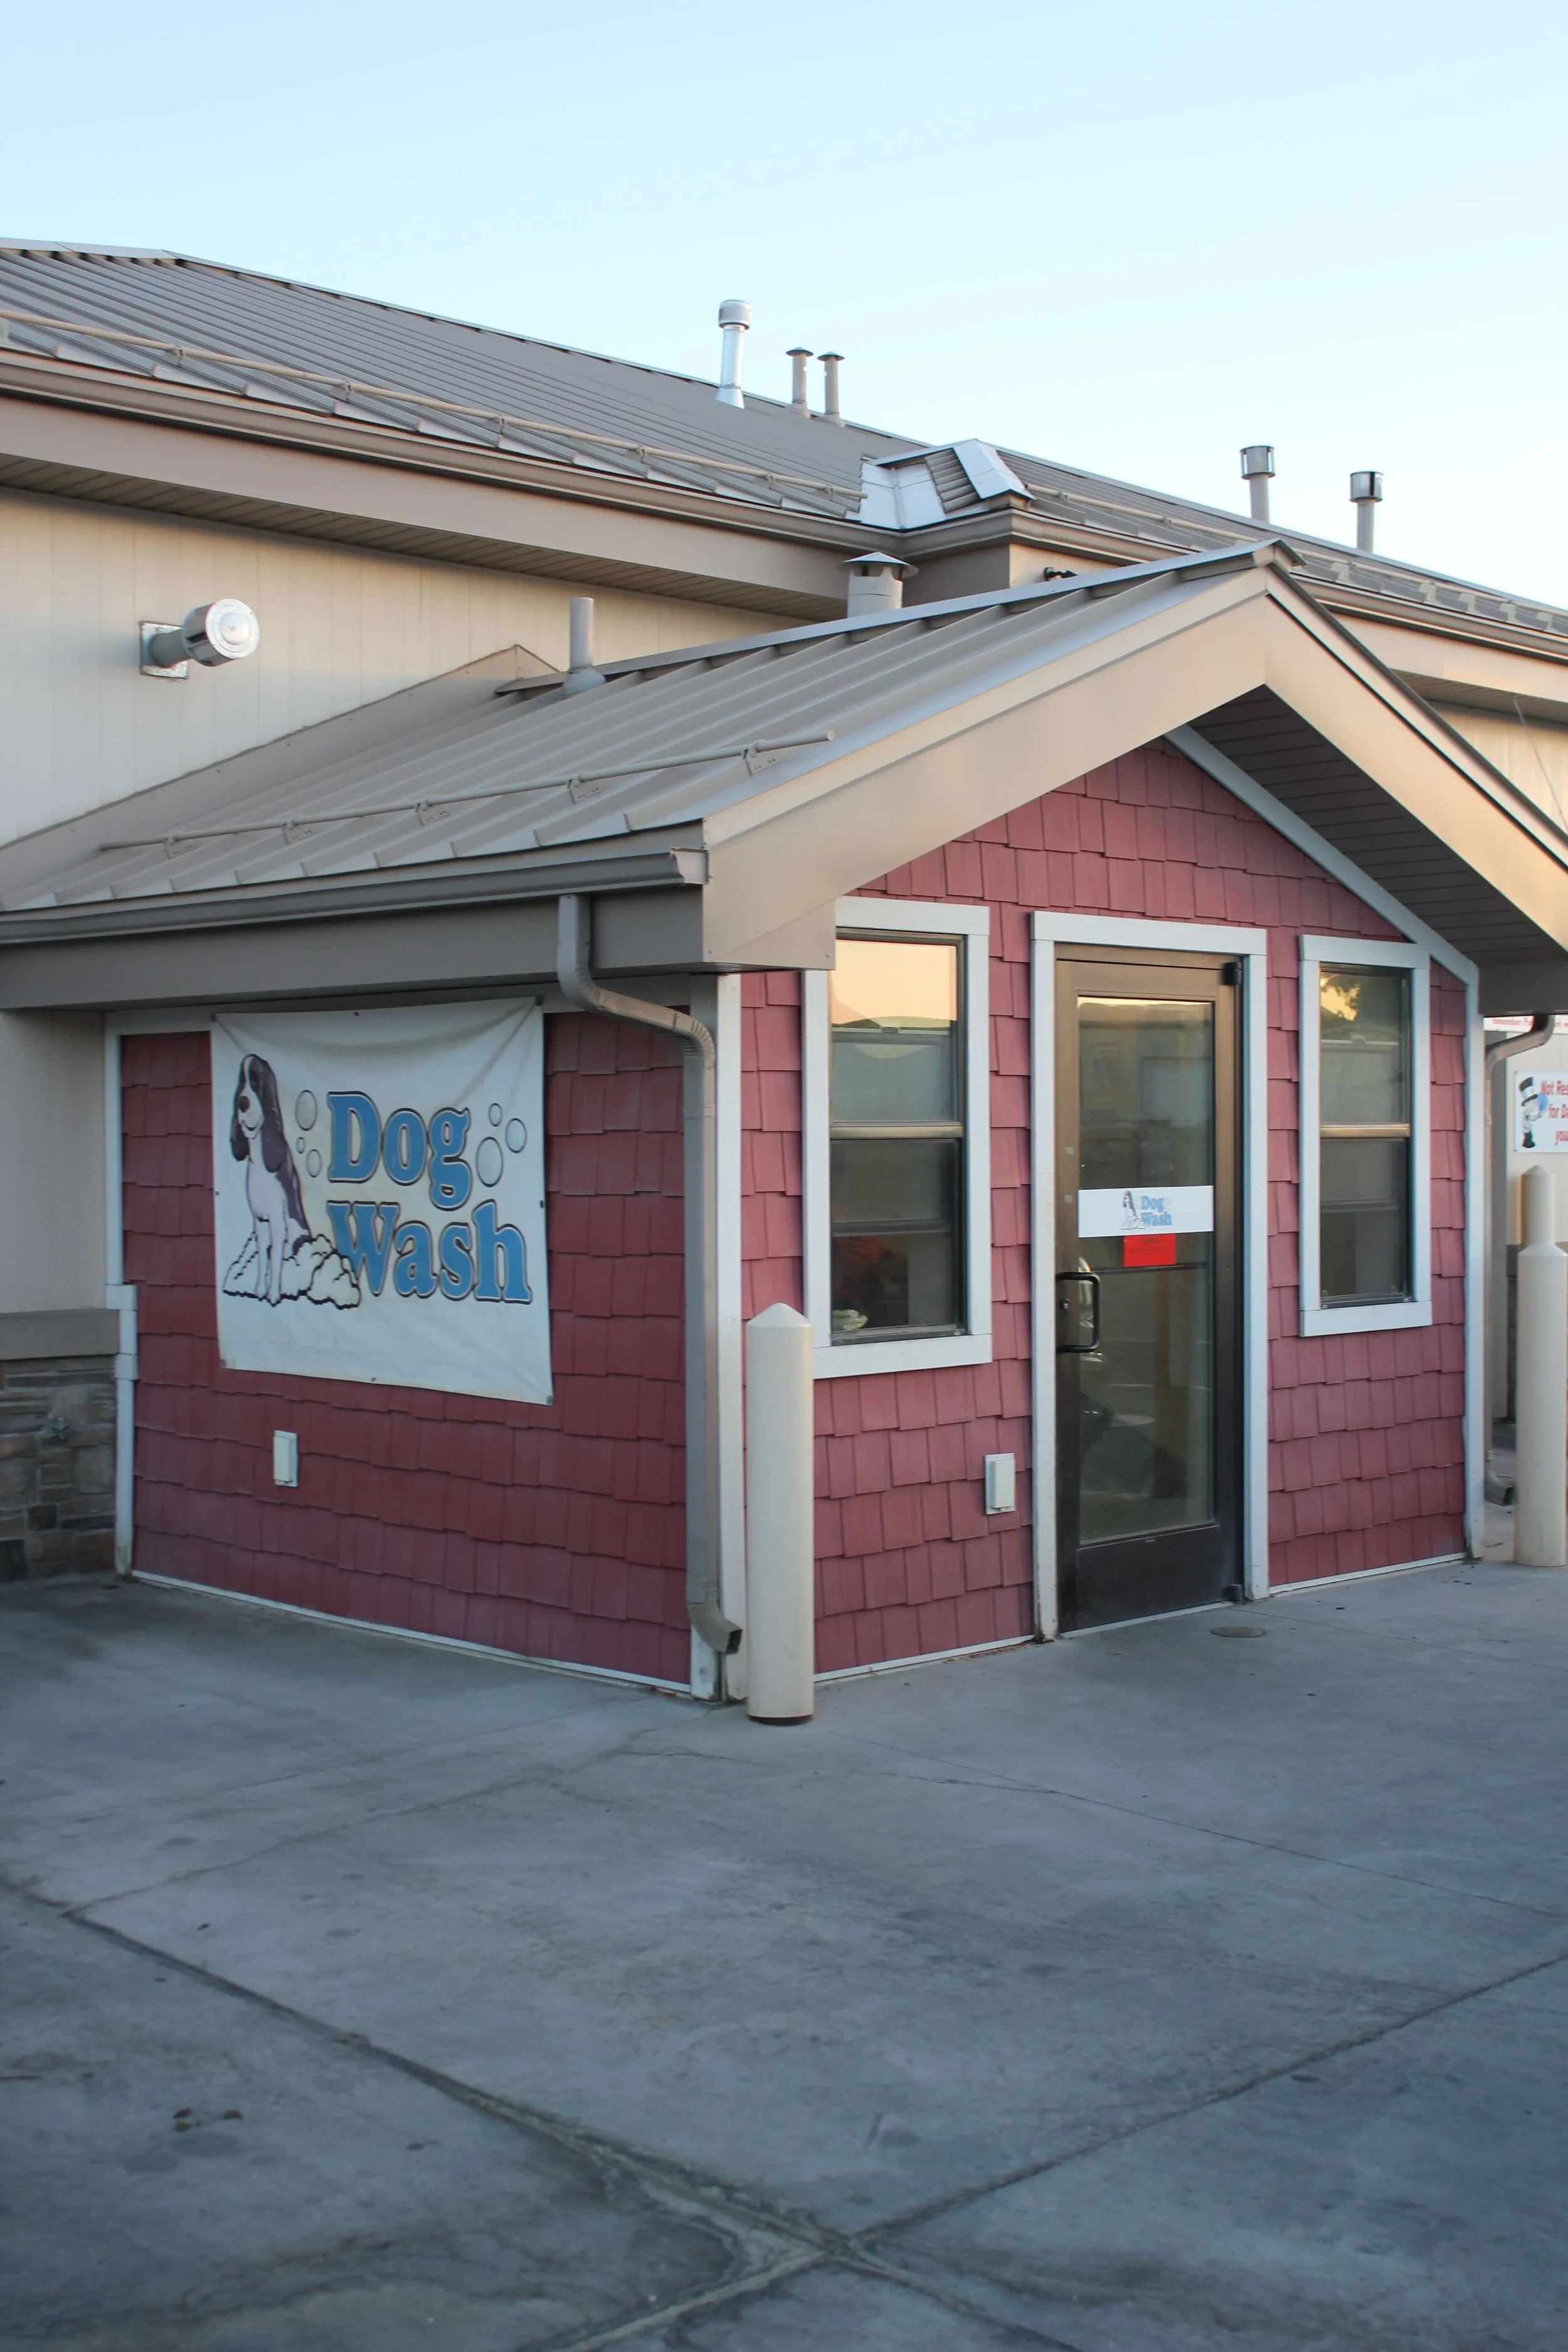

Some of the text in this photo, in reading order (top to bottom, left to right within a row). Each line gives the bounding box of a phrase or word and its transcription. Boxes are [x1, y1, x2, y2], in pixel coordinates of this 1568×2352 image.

[326, 1090, 474, 1211] Dog
[1141, 1195, 1165, 1212] Dog
[1142, 1210, 1172, 1226] Wash
[326, 1199, 532, 1305] Wash
